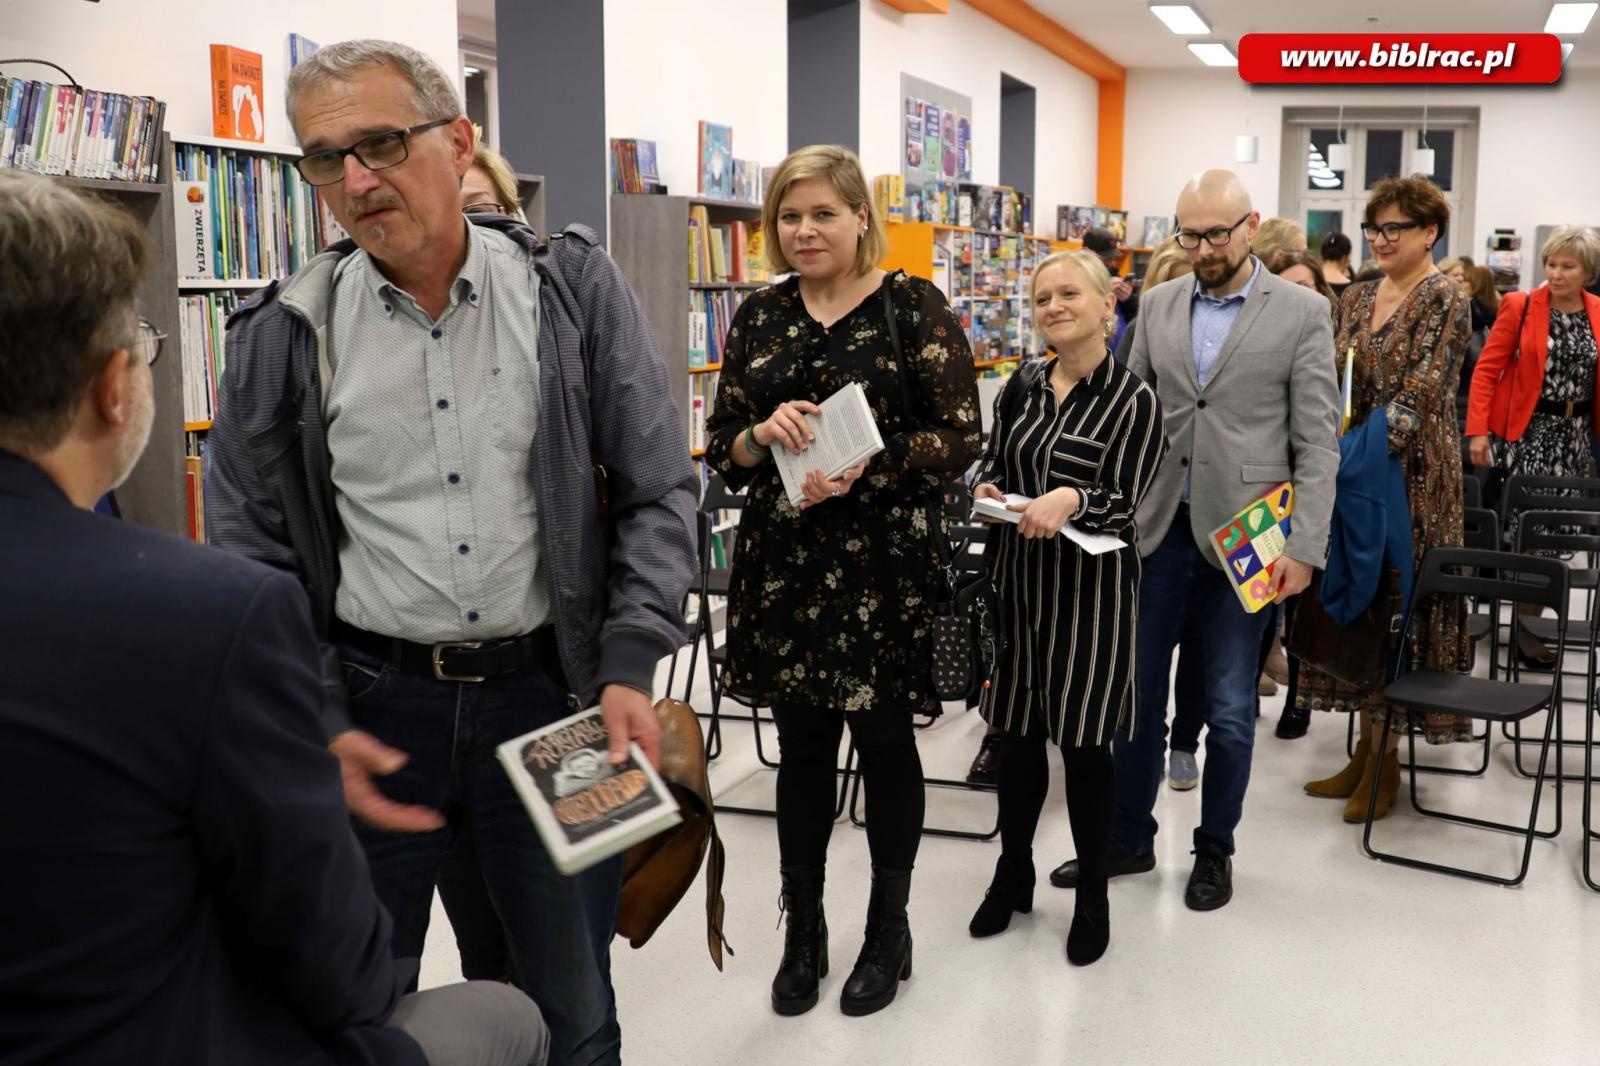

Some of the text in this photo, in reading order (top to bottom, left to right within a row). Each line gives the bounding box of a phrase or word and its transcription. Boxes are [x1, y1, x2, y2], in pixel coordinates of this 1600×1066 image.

[231, 63, 261, 80] NA DWORZE
[194, 209, 205, 272] ZWIERZĘTA
